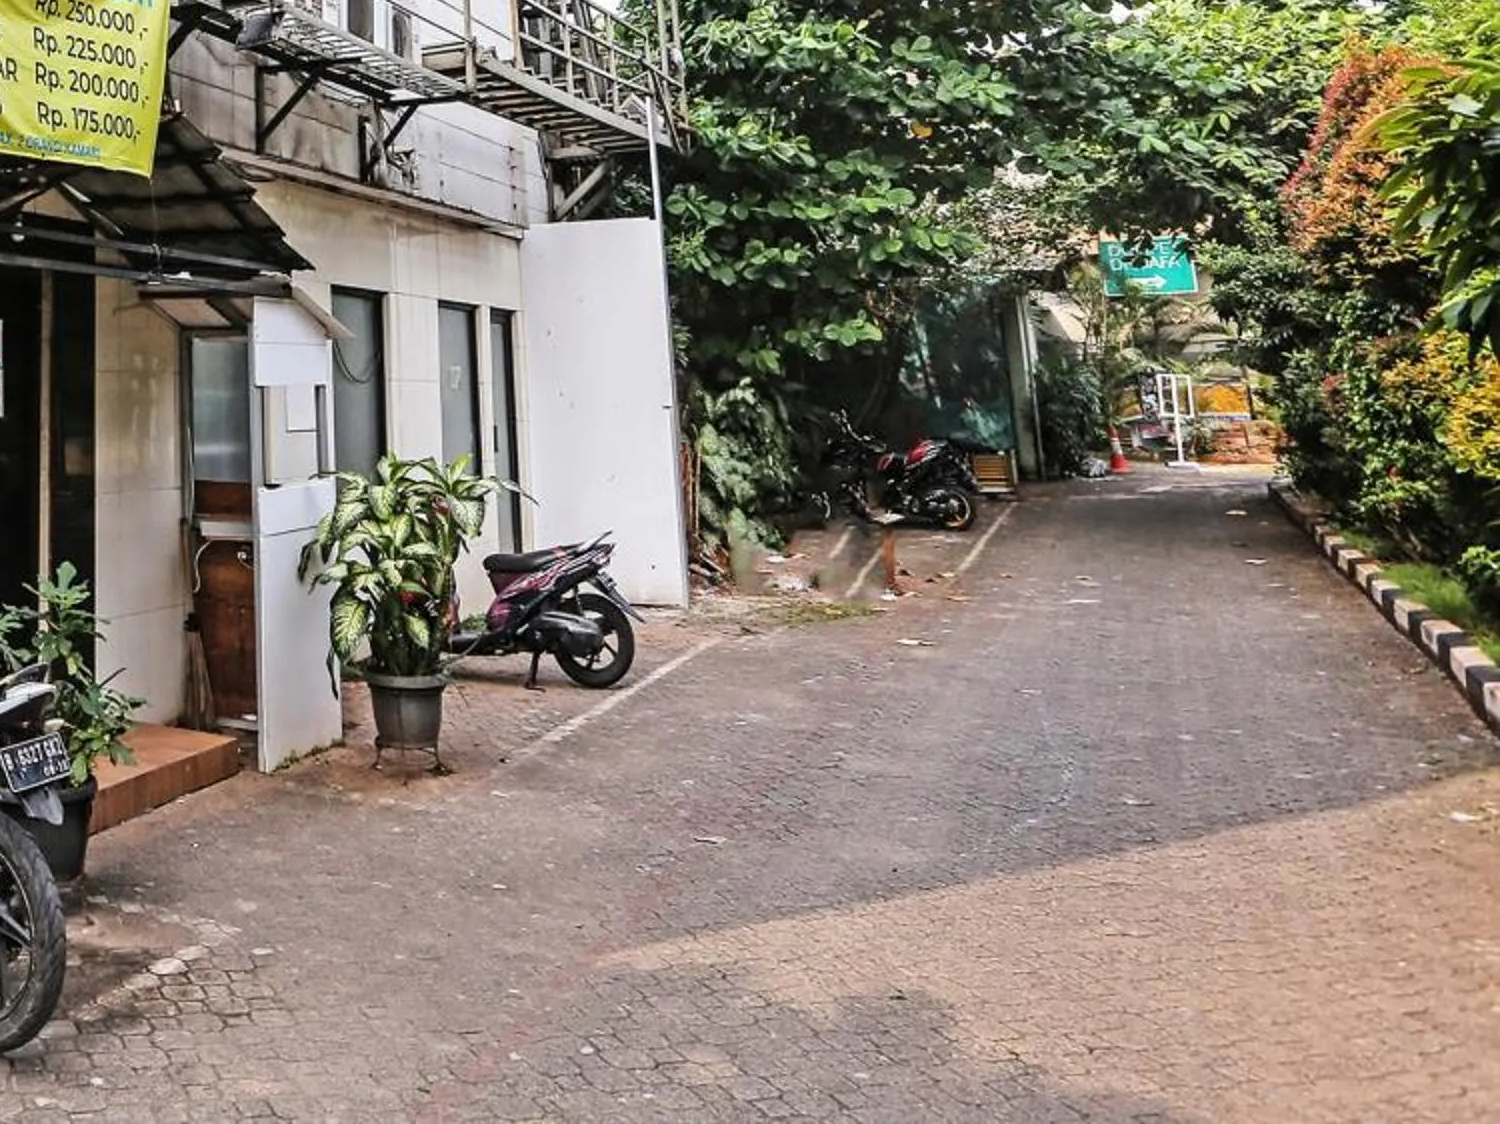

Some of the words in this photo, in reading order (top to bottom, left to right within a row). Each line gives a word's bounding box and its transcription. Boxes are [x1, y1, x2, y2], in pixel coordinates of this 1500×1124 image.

[33, 26, 62, 57] Rp.
[35, 62, 64, 93] Rp.
[37, 101, 67, 132] Rp.
